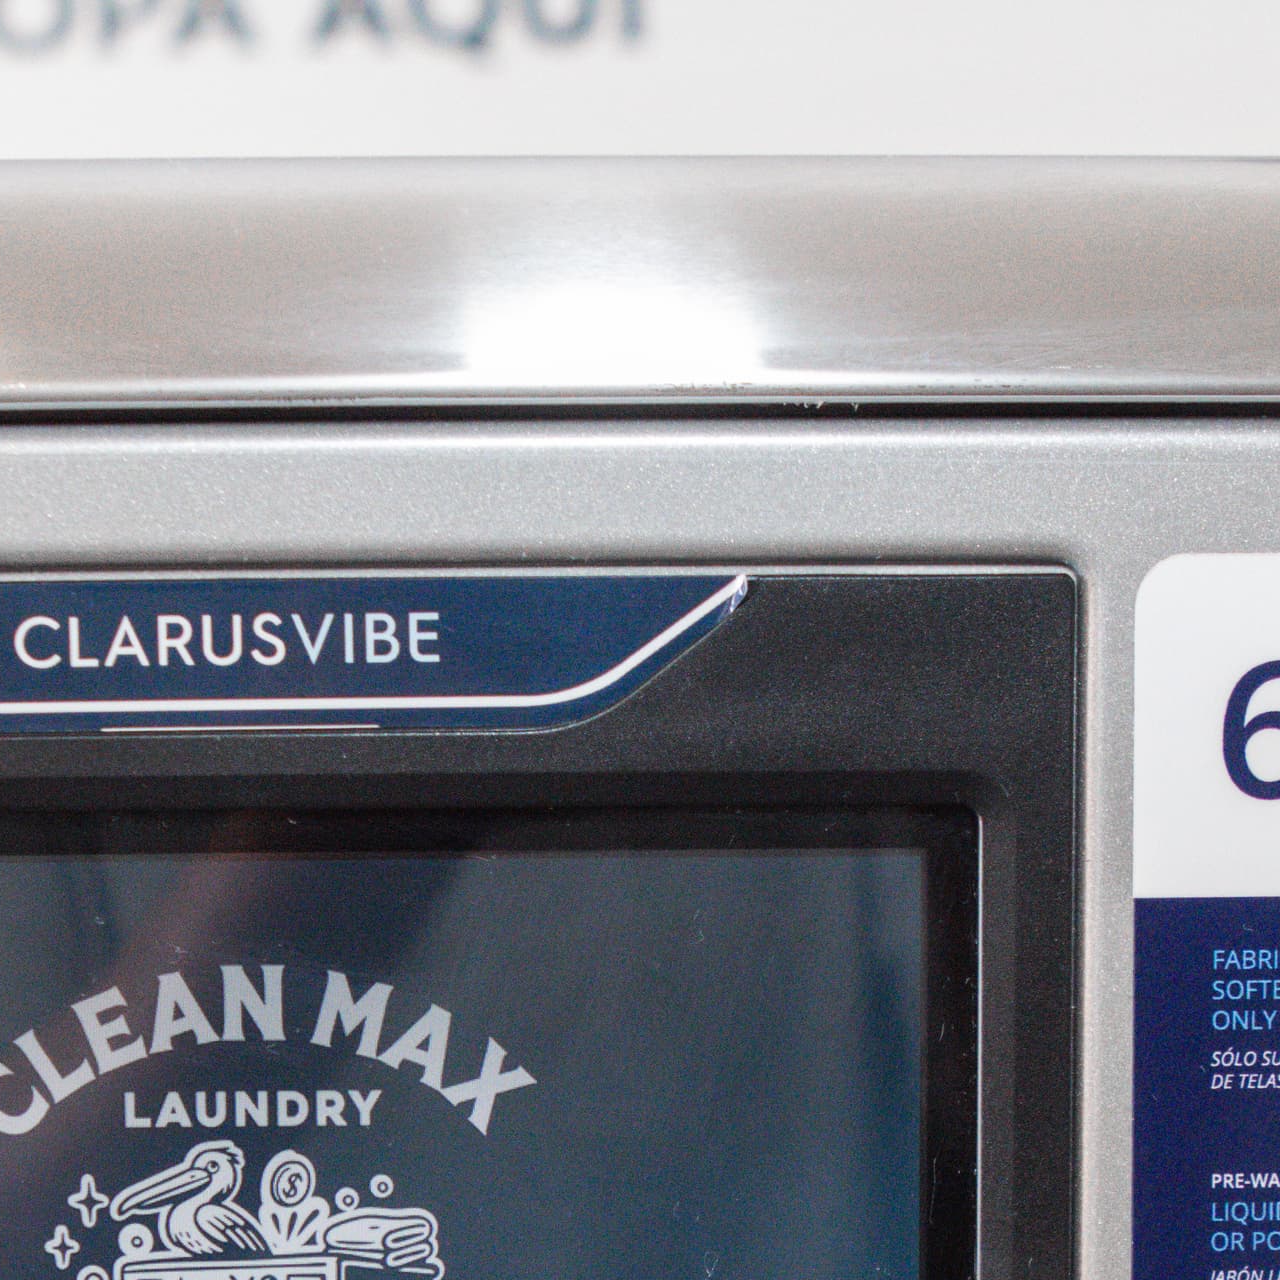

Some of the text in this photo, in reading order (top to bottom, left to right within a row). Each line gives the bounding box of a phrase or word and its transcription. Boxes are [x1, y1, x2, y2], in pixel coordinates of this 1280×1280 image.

[14, 612, 440, 669] CLARUSVIBE
[1212, 1010, 1277, 1030] ONLY
[311, 971, 537, 1135] MAX
[1210, 1047, 1257, 1067] SÓLO
[1211, 1074, 1234, 1089] DE
[124, 1089, 382, 1128] LAUNDRY
[1211, 1232, 1245, 1252] OR
